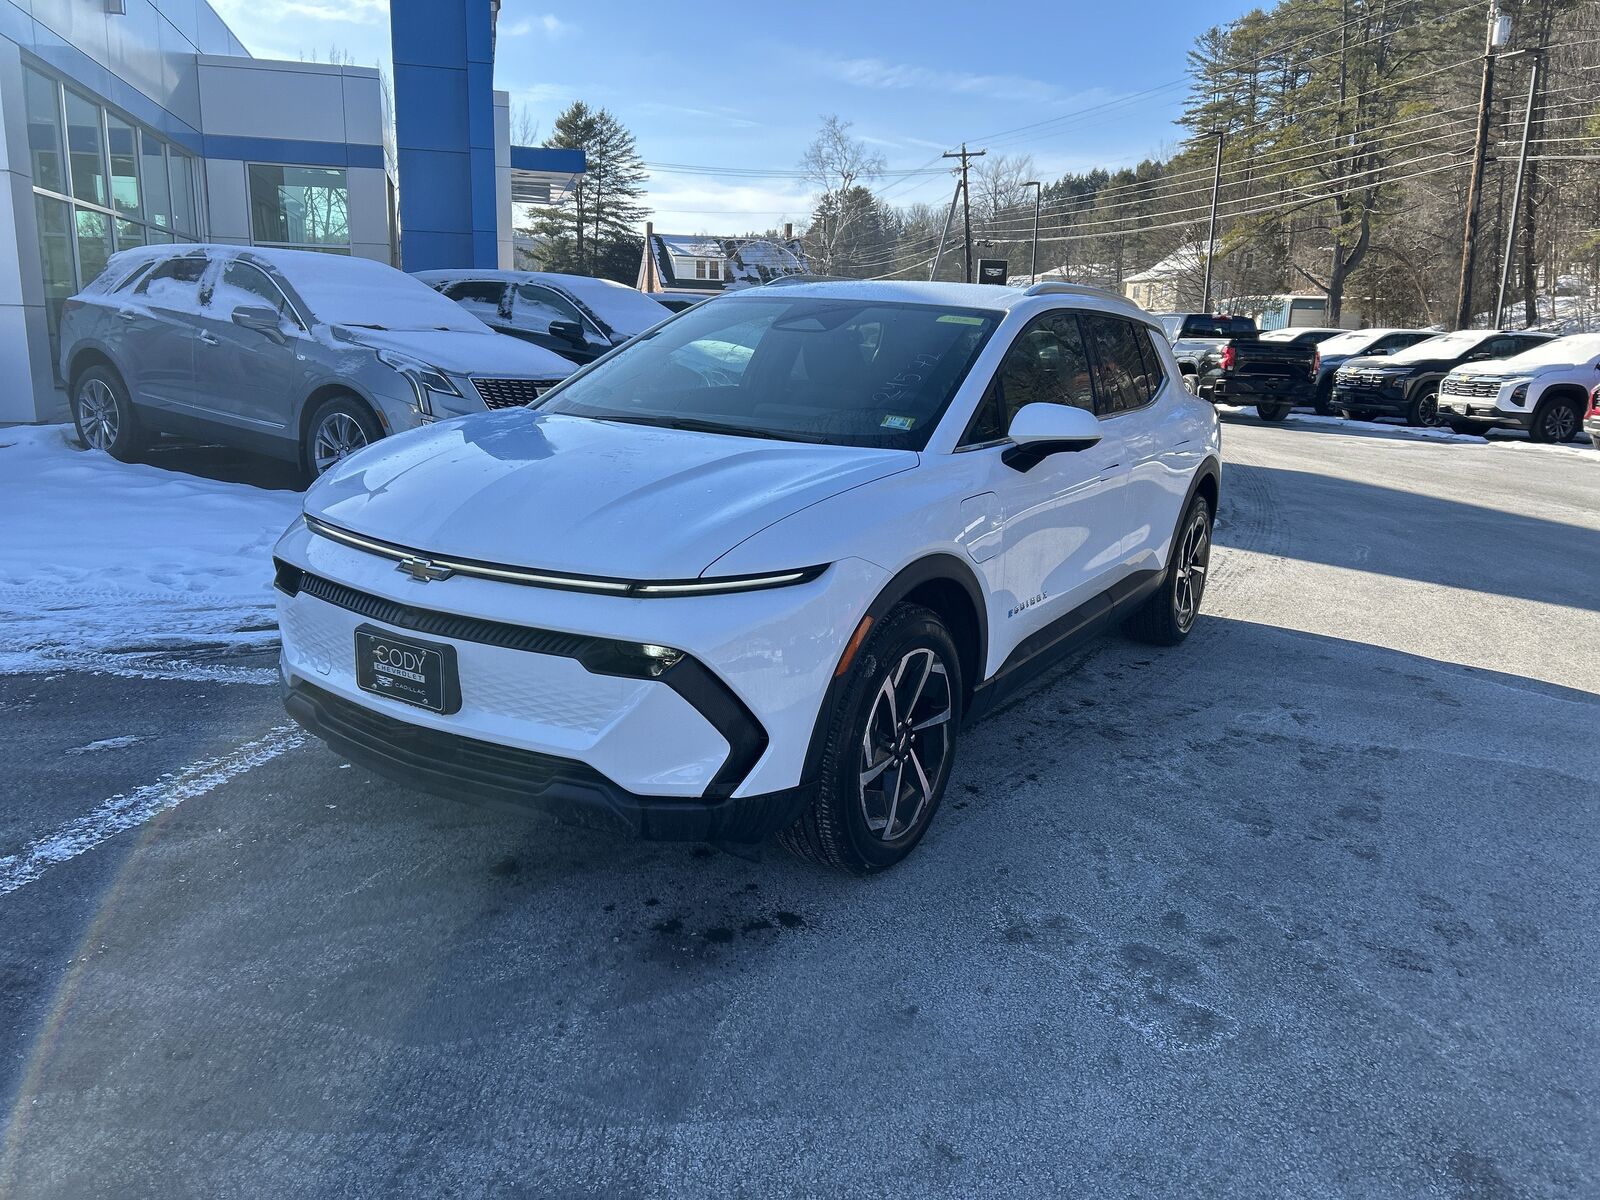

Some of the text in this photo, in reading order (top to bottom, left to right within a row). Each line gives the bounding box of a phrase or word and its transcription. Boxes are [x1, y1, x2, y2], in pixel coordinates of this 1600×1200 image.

[376, 645, 425, 673] CODY
[375, 663, 424, 681] CHEVROLET
[394, 682, 426, 696] CADILLAC
